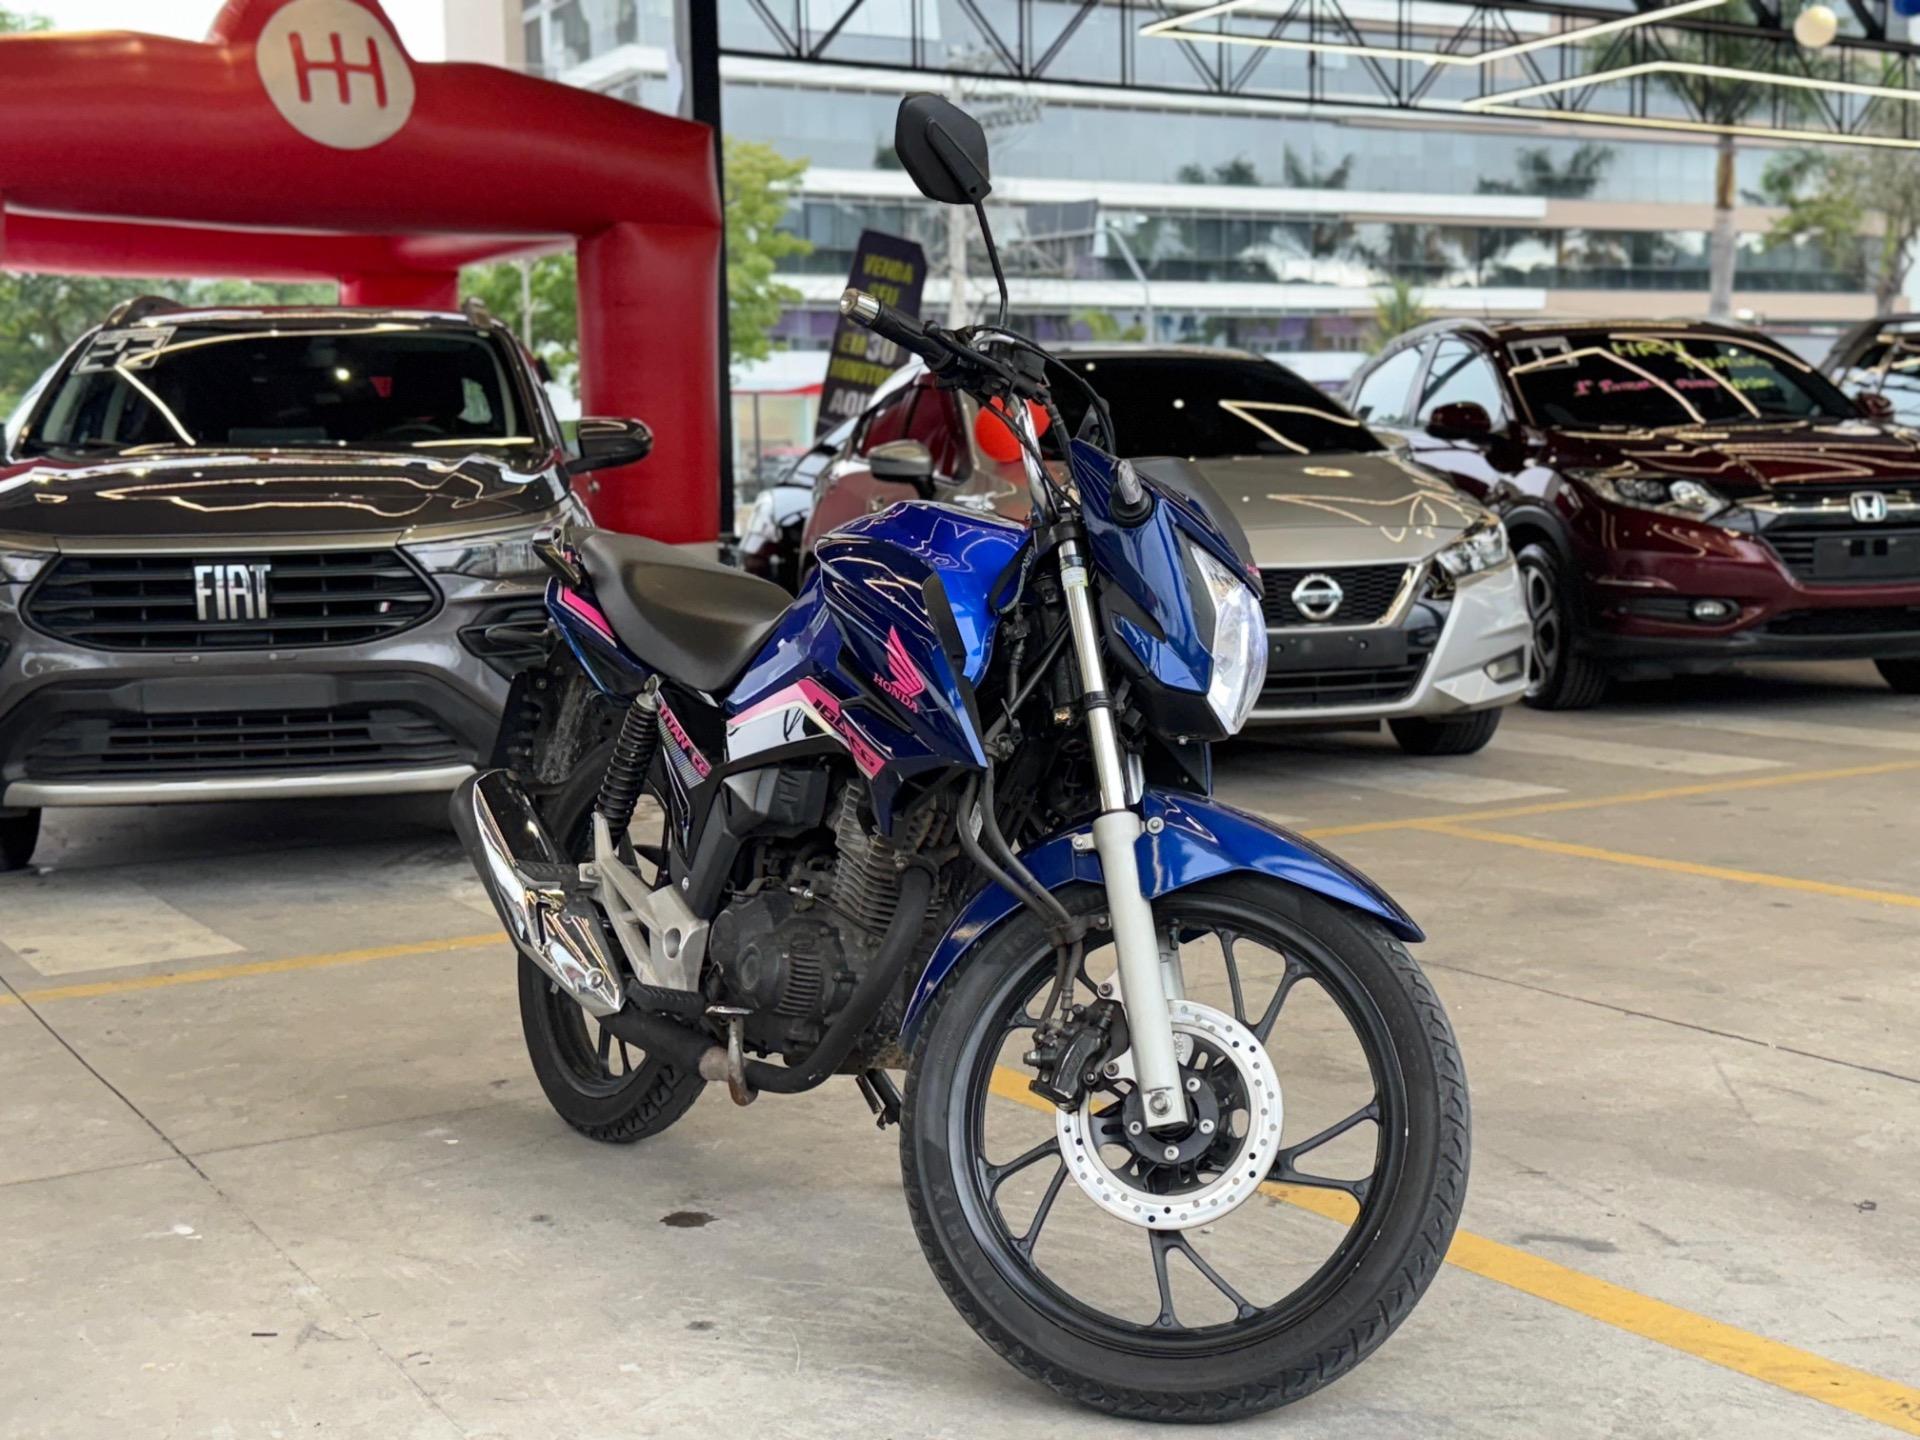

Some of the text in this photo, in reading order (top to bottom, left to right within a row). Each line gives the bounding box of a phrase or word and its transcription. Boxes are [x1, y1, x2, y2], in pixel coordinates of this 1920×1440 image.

[864, 255, 913, 284] VENDA
[194, 564, 271, 620] FIAT
[873, 673, 919, 714] HONDA
[658, 703, 691, 750] TITAN
